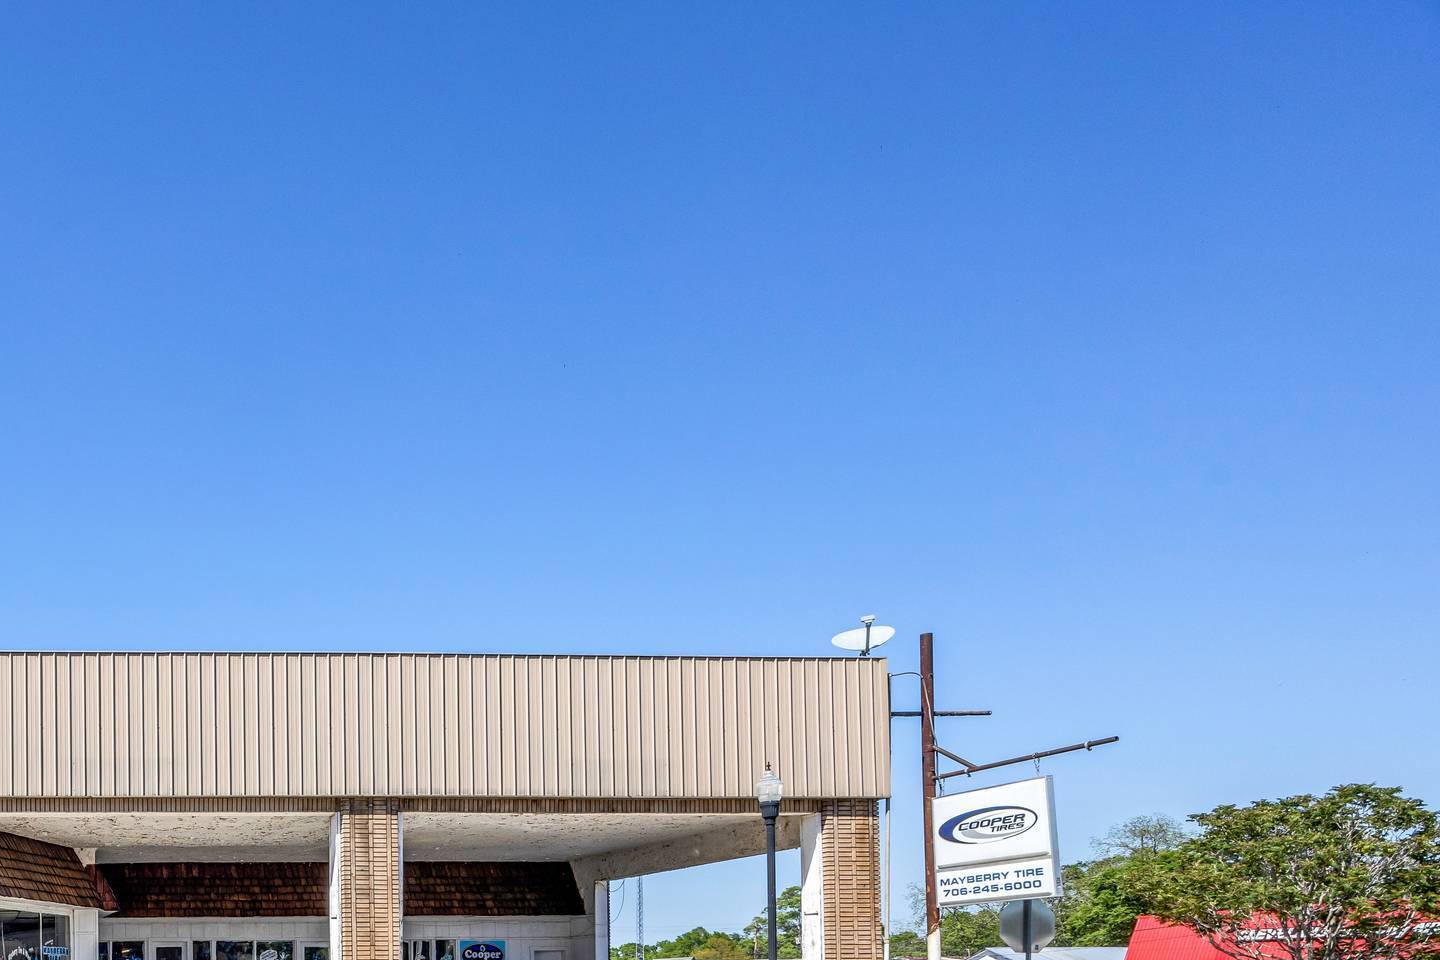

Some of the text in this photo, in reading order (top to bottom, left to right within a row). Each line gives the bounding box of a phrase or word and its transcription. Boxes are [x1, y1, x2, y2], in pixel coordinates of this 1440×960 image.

[958, 813, 1026, 831] COOPER
[990, 821, 1025, 833] TIRES
[940, 867, 1044, 887] MAYBERRY TIRE
[943, 879, 1042, 897] 706-245-6000
[464, 950, 501, 960] Cooper
